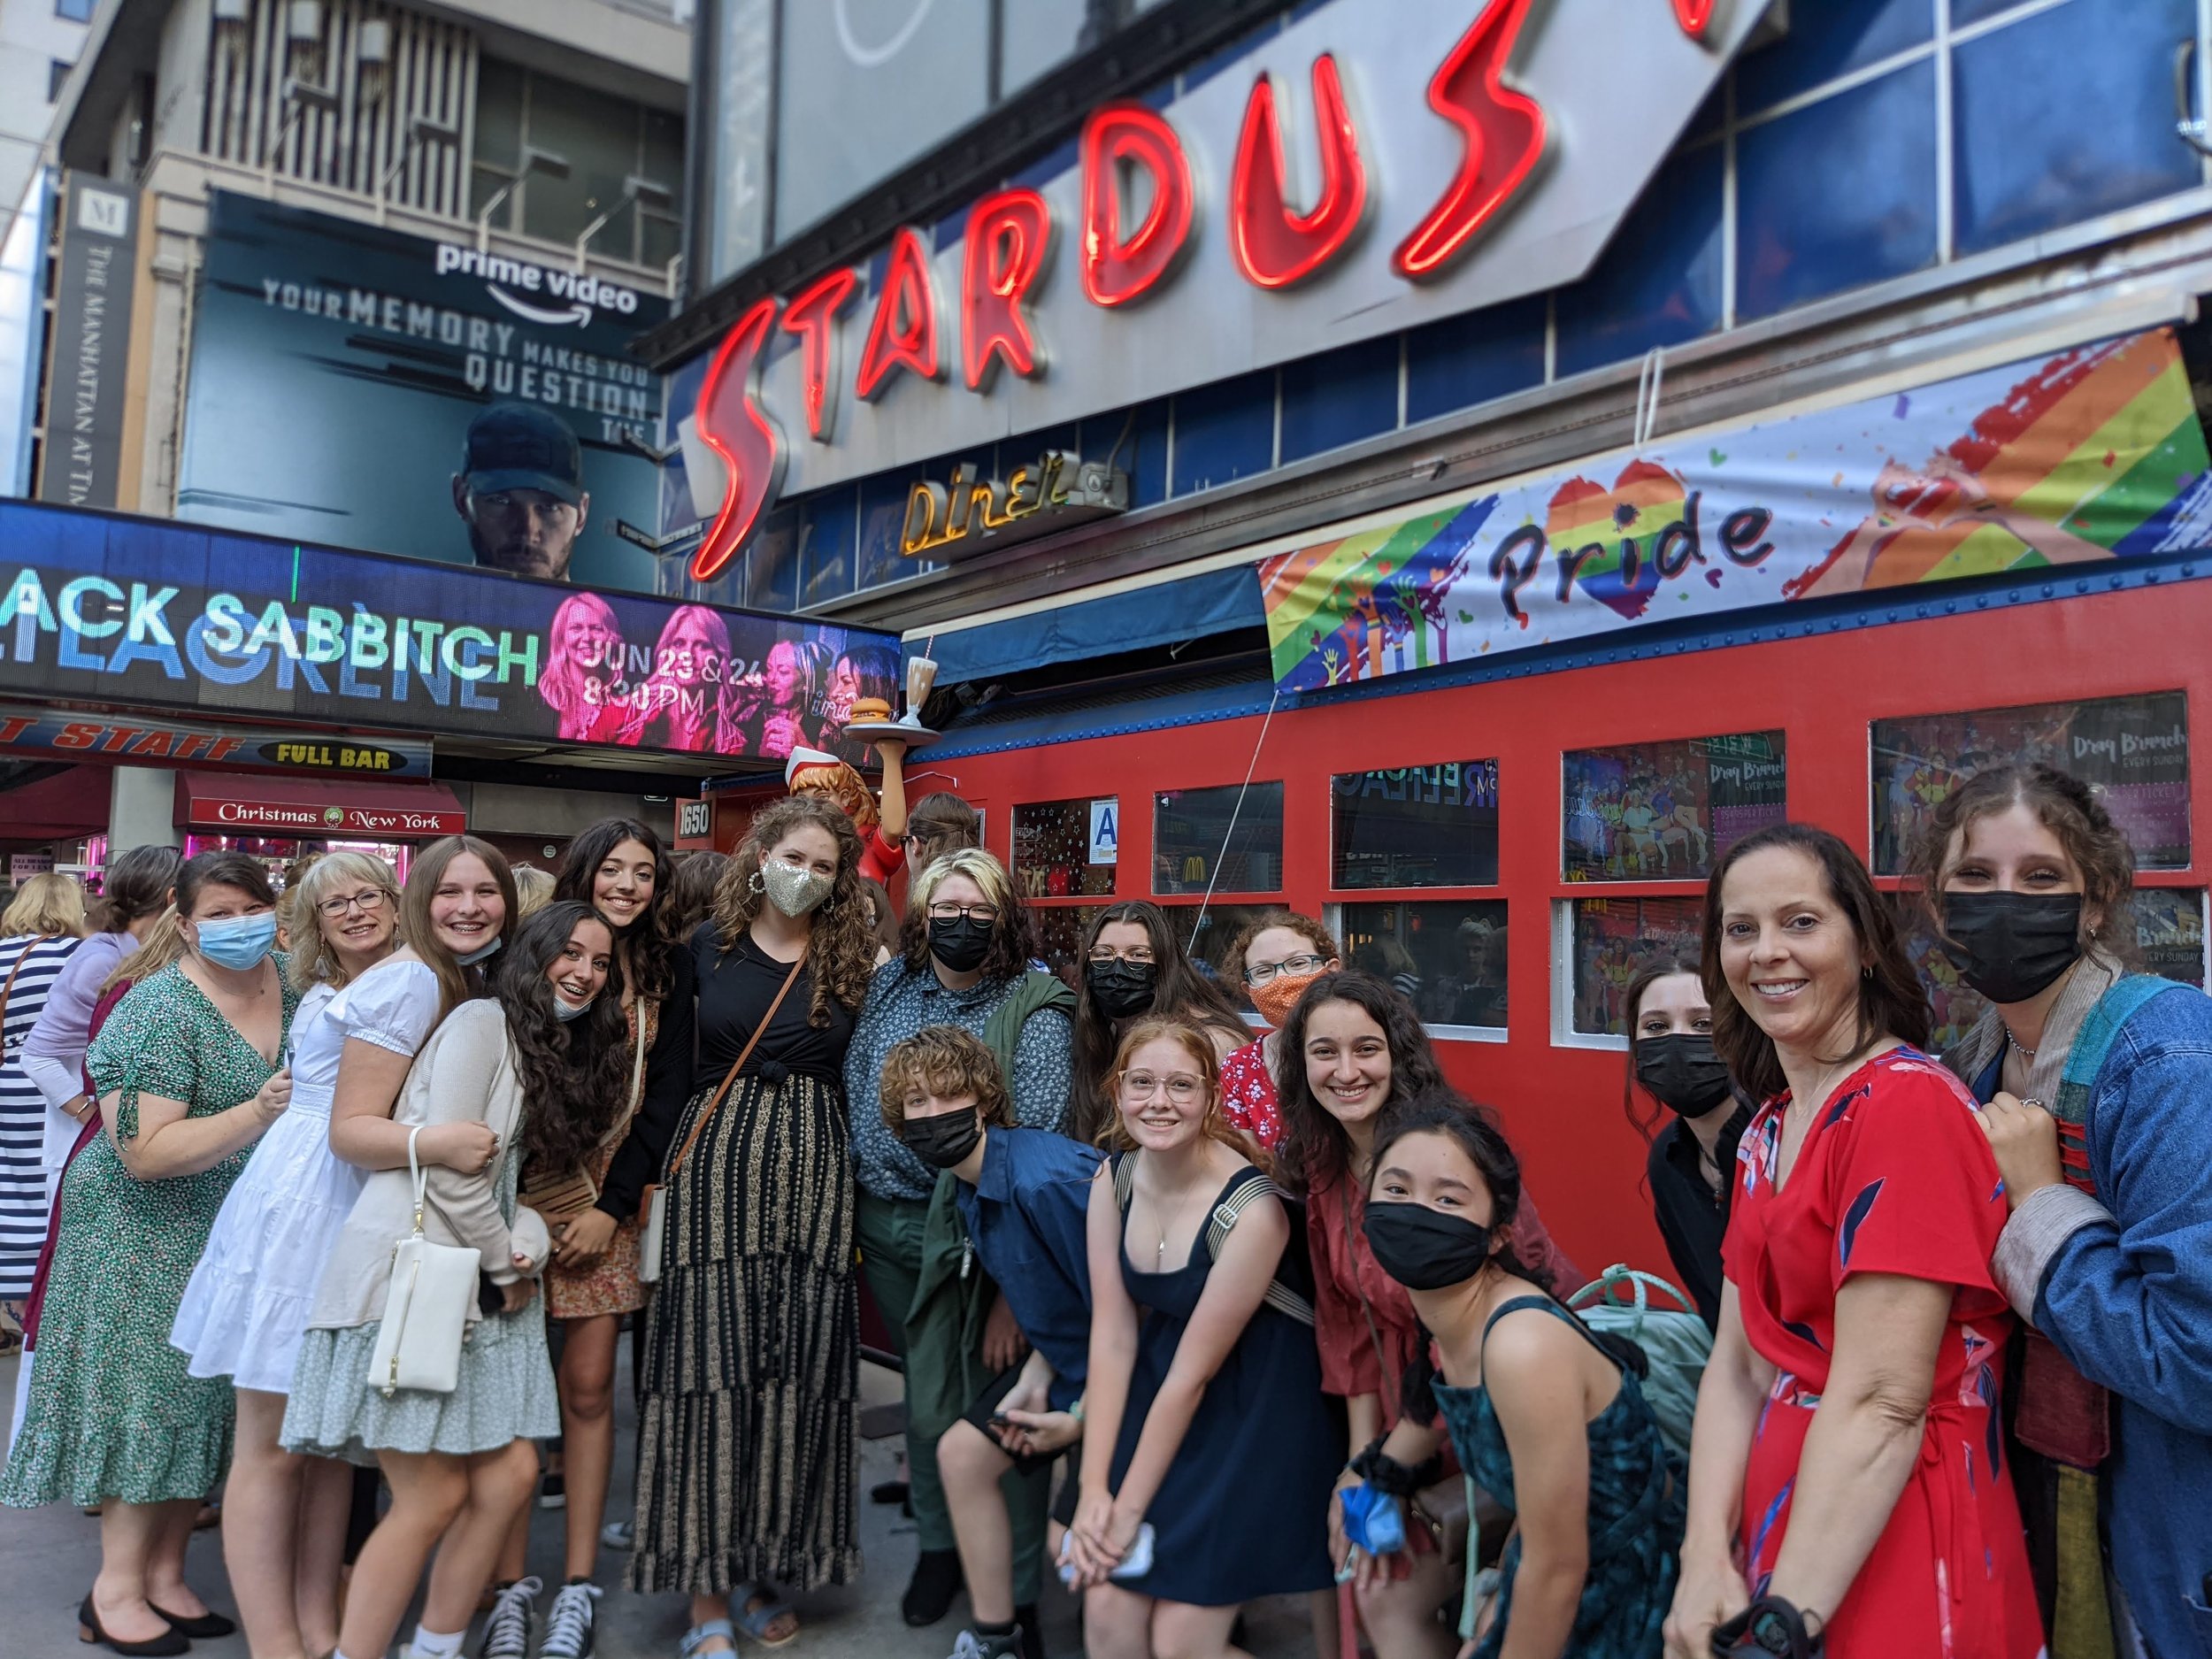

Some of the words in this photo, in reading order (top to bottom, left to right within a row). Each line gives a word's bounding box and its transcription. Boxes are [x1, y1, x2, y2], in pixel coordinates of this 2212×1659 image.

[85, 246, 113, 289] THE
[436, 242, 541, 290] prime
[546, 270, 638, 315] video
[263, 278, 342, 320] YOUR
[347, 288, 516, 357] MEMORY
[522, 340, 598, 377] MAKES
[606, 359, 649, 388] YOU
[74, 292, 107, 434] MANHATTAN
[464, 354, 648, 422] QUESTION
[71, 436, 93, 466] AT
[1487, 489, 1773, 630] Pride
[201, 592, 539, 687] SABBITCH
[583, 639, 650, 676] JUN
[657, 649, 695, 680] 23
[701, 654, 723, 684] &
[728, 658, 764, 689] 24
[582, 676, 651, 710] 8:30
[658, 683, 707, 718] PM
[51, 722, 247, 762] STAFF
[276, 744, 334, 767] FULL
[340, 748, 390, 771] BAR
[2073, 735, 2116, 764] Drag
[2120, 724, 2186, 756] Brunch
[2123, 757, 2150, 768] EVERY
[2152, 755, 2185, 767] SUNDAY
[1710, 763, 1740, 787] Drag
[1745, 780, 1765, 791] EVERY
[219, 803, 318, 823] Christmas
[349, 810, 396, 829] New
[400, 813, 441, 830] York
[679, 803, 709, 835] 1650
[1094, 807, 1118, 846] A
[2166, 951, 2199, 963] SUNDAY
